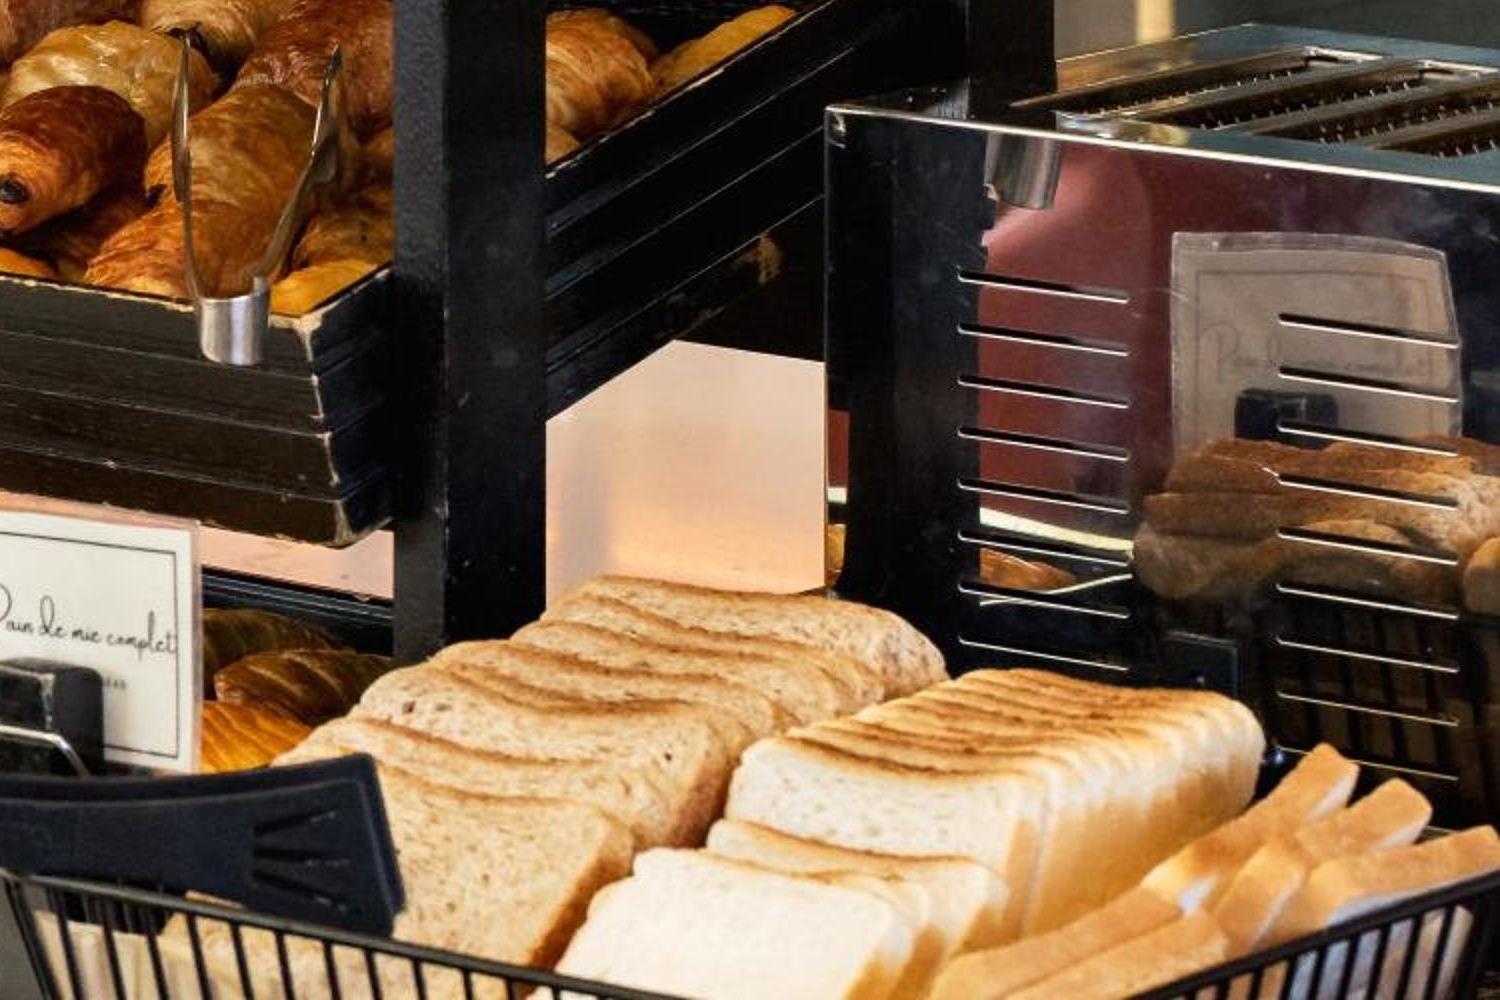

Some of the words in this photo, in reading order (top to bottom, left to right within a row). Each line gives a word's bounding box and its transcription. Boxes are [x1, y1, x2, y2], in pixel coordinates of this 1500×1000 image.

[39, 594, 68, 639] de
[71, 626, 101, 644] mie
[106, 609, 179, 662] complet
